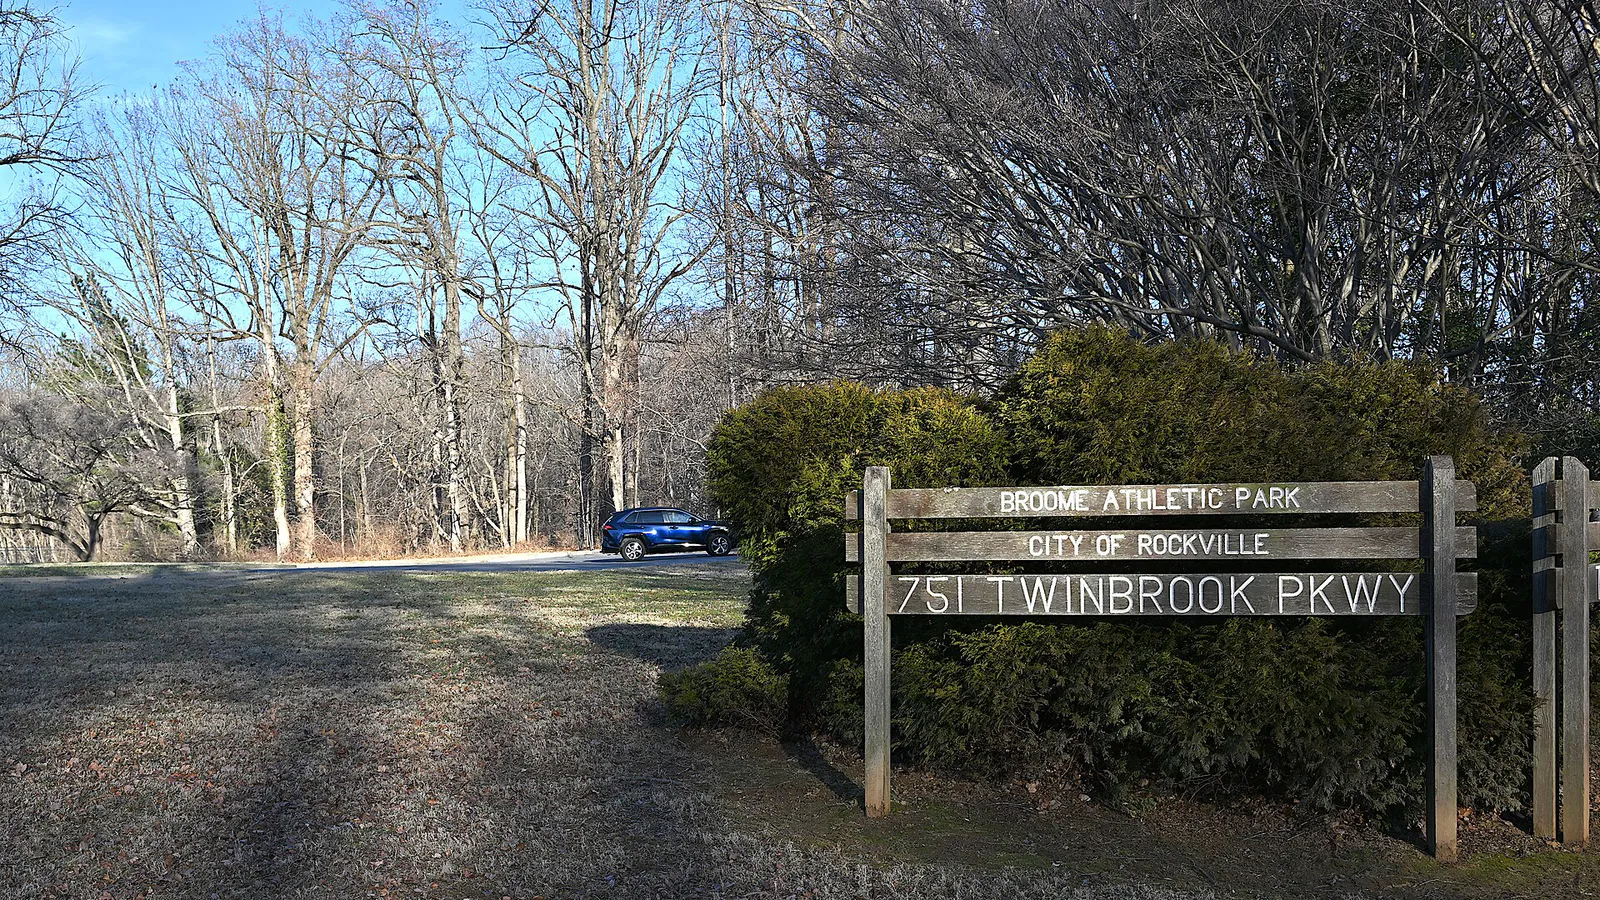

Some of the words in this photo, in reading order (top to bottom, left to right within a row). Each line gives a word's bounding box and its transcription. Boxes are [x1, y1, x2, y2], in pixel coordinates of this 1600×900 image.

[1000, 489, 1089, 513] BROOME
[1102, 487, 1223, 511] ATHLETIC
[1235, 486, 1301, 509] PARK
[1028, 534, 1083, 556] CITY
[1096, 534, 1125, 556] OF
[1137, 532, 1270, 556] ROCKVILLE
[898, 576, 964, 614] 751
[986, 575, 1256, 614] TWINBROOK
[1277, 573, 1415, 614] PKWY
